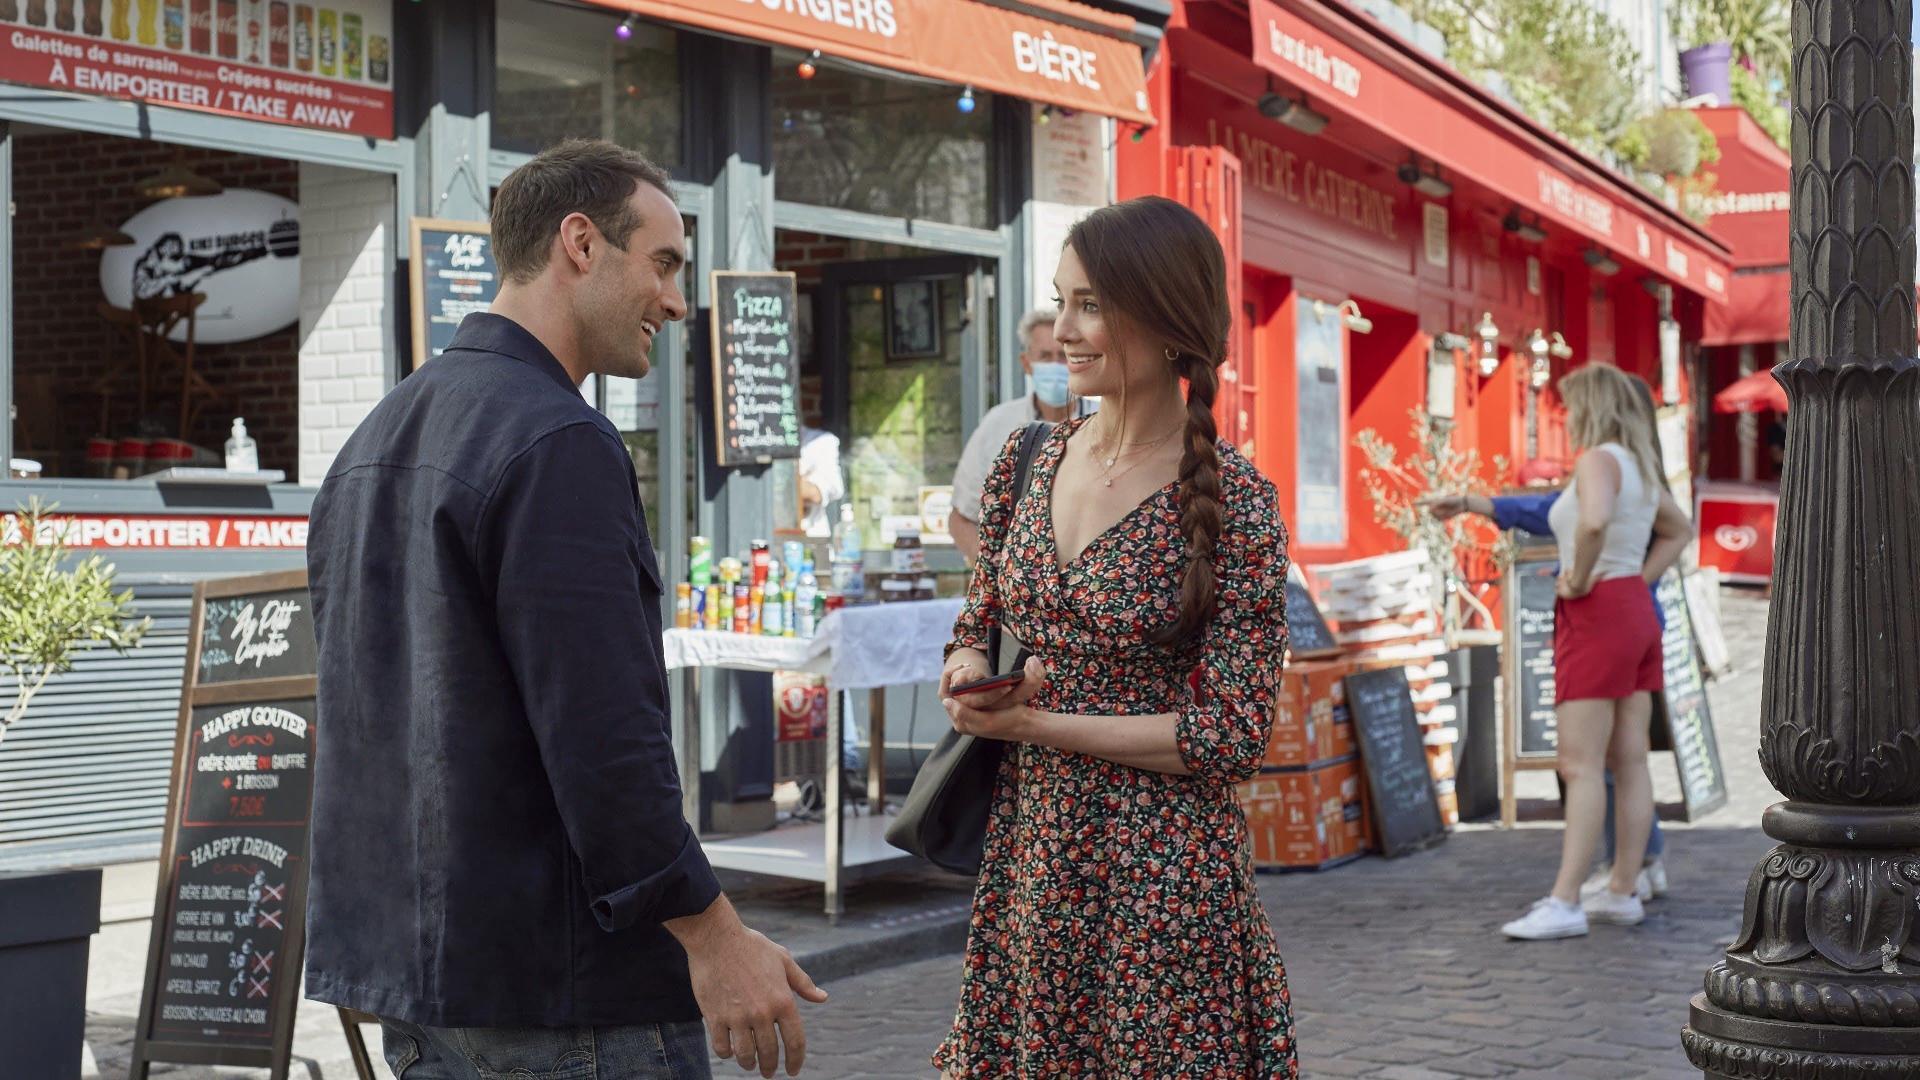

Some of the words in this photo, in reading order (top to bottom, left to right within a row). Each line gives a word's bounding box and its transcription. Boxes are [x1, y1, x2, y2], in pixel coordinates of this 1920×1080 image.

[735, 0, 897, 38] GERS
[11, 31, 84, 58] Galettes
[87, 45, 108, 63] de
[113, 50, 179, 74] sarrasin
[217, 65, 271, 91] Crêpes
[274, 77, 333, 101] sucrées
[1012, 30, 1101, 91] BIÈRE
[49, 58, 68, 85] À
[74, 66, 209, 105] EMPORTER
[214, 87, 224, 108] /
[228, 90, 288, 119] TAKE
[292, 101, 355, 130] AWAY
[1303, 159, 1398, 241] CATHERINE
[35, 518, 211, 547] EMPORTER
[216, 520, 230, 547] /
[234, 520, 308, 547] TAKE
[201, 708, 251, 743] HAPPY
[243, 774, 280, 790] BOISSON
[190, 836, 243, 868] HAPPY
[243, 836, 288, 869] DRINK
[183, 953, 207, 969] CHAUD
